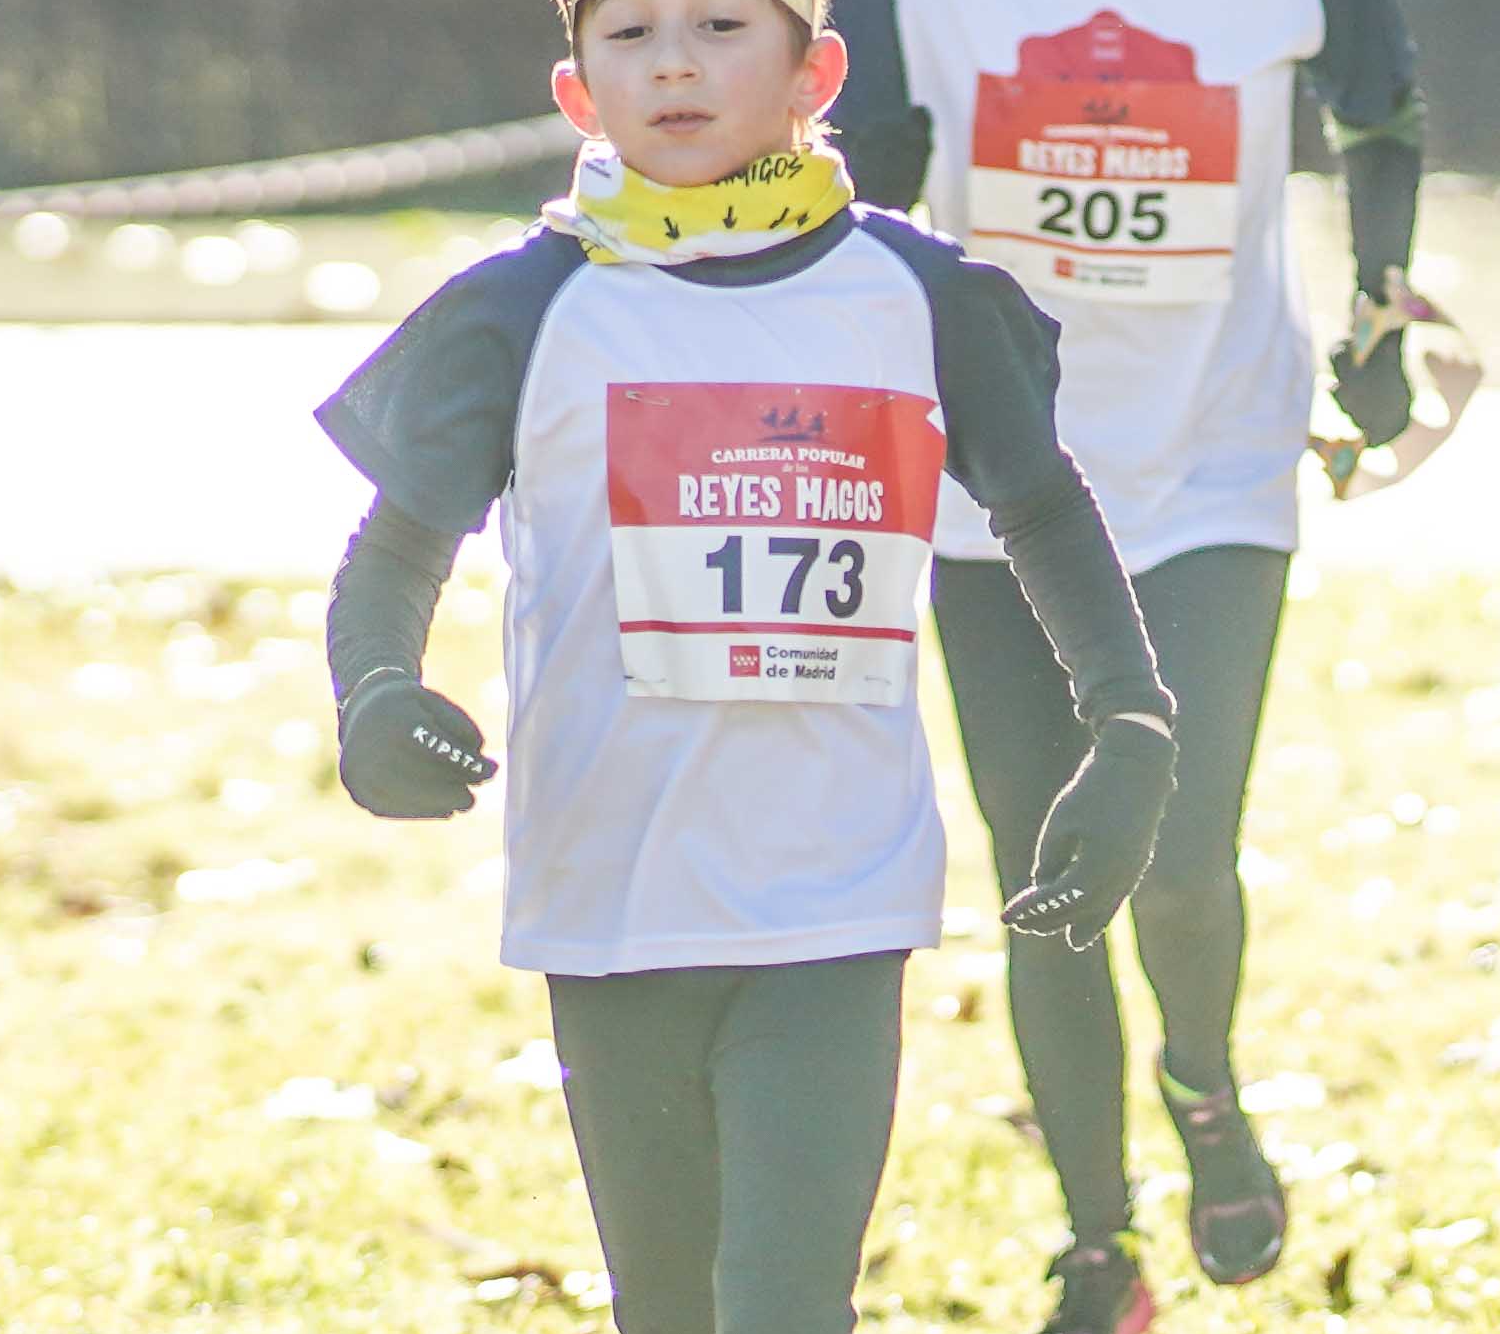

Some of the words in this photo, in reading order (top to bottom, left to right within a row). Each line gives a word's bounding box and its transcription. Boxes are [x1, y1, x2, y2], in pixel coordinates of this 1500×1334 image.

[1038, 186, 1169, 242] 205
[711, 447, 794, 464] CARRERA
[797, 447, 866, 470] POPULAR
[678, 474, 782, 519] REYES
[796, 476, 884, 523] MAGOS
[706, 535, 865, 619] 173
[766, 646, 838, 661] Comunidad
[766, 665, 789, 678] de
[795, 665, 836, 680] Madrid
[412, 724, 484, 773] KIPSTA
